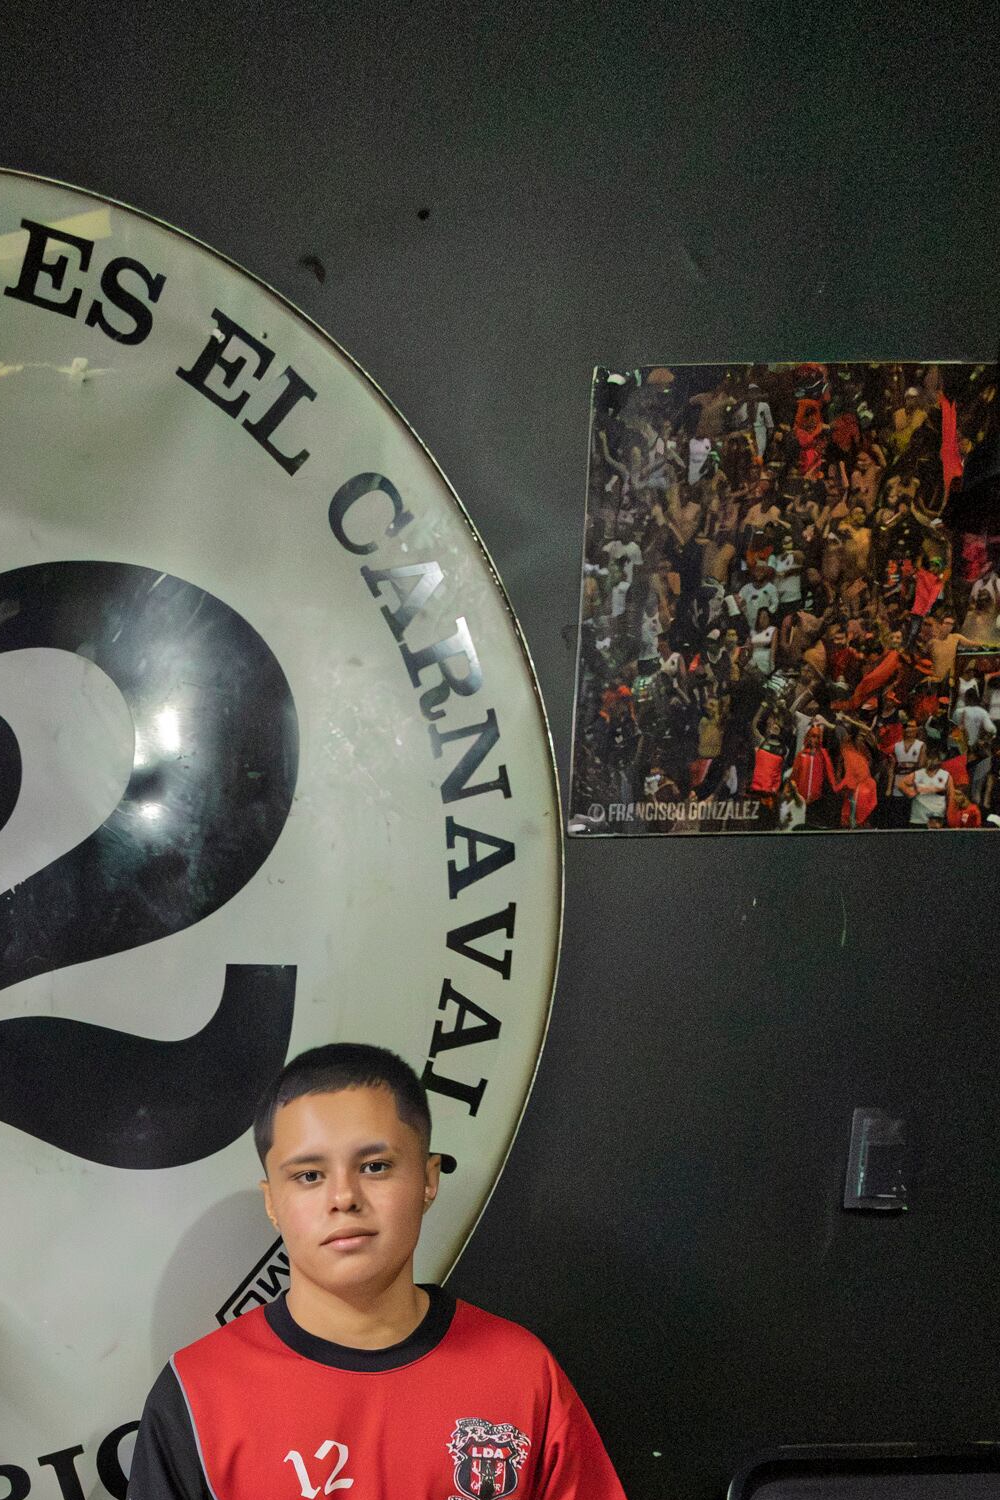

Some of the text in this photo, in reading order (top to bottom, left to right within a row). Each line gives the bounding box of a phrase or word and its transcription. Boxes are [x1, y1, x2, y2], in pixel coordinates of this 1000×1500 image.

[3, 218, 167, 345] ES
[175, 308, 318, 476] EL
[608, 802, 685, 822] FRANCISCO
[688, 801, 760, 820] GONZALEZ
[283, 1439, 354, 1500] 12
[471, 1446, 505, 1459] LDA
